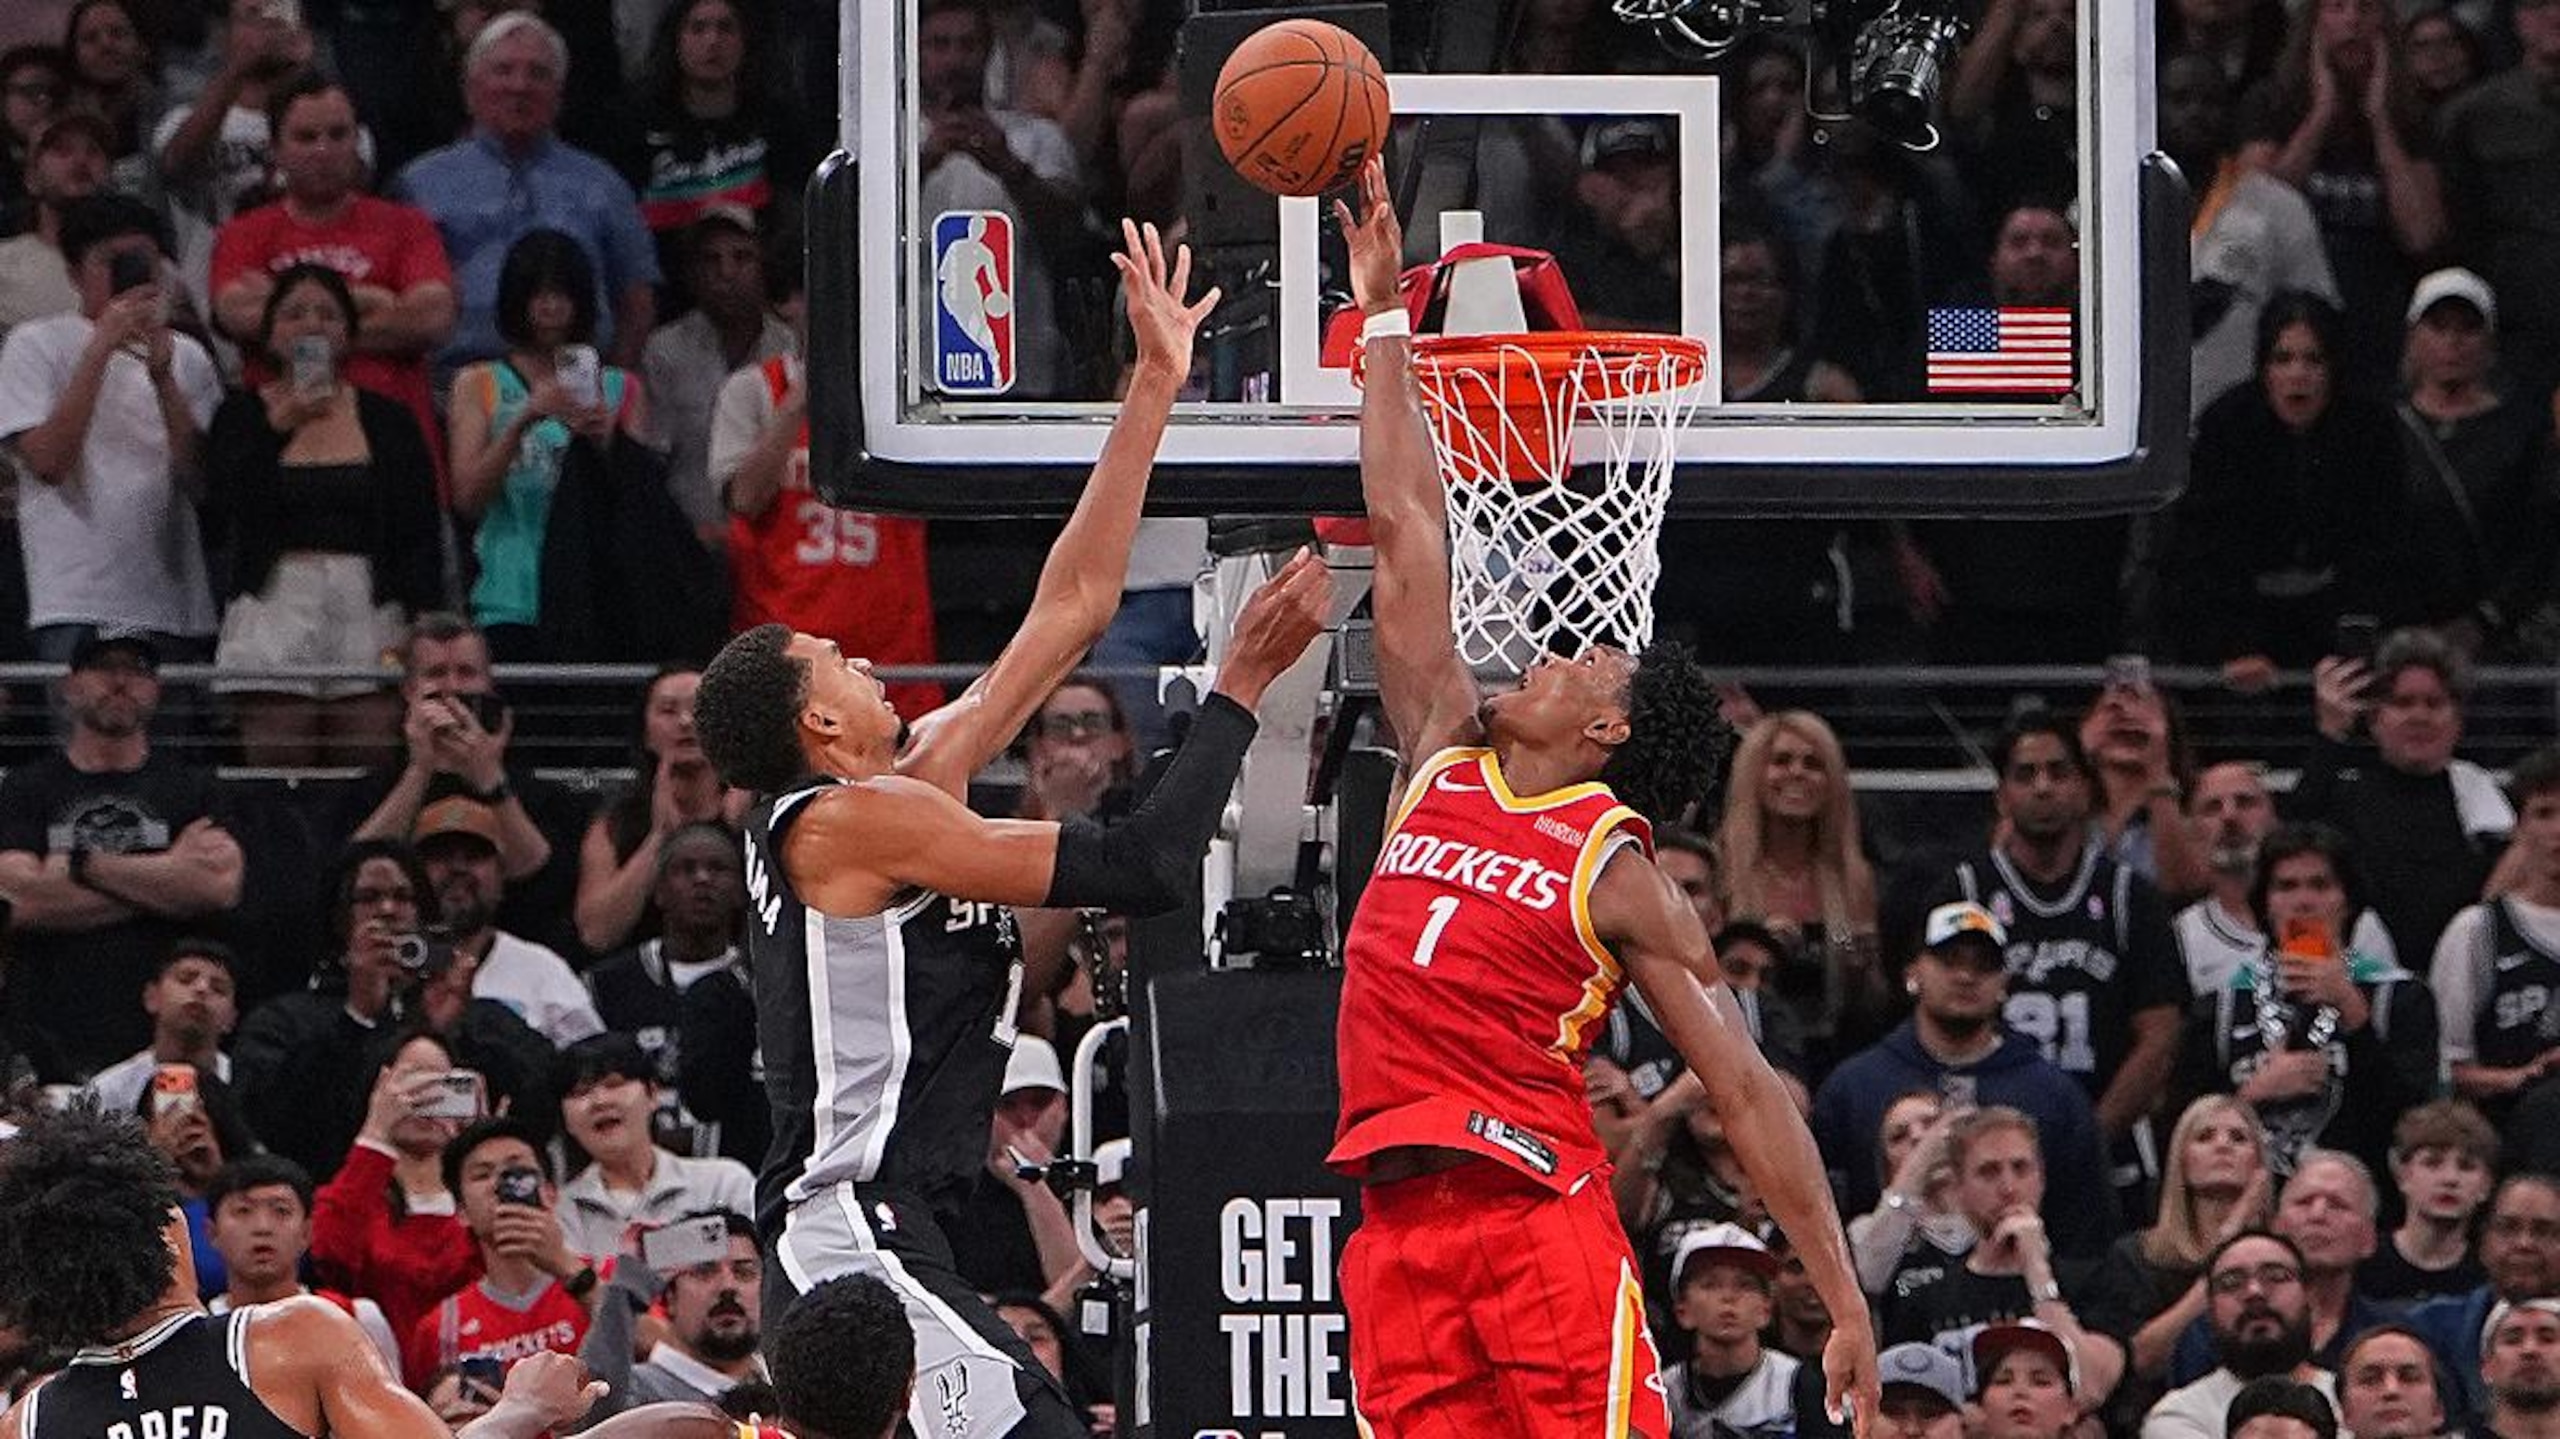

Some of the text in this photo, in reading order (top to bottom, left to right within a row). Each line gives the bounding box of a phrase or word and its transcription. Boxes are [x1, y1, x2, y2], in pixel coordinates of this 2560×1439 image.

[946, 352, 985, 382] NBA
[796, 501, 878, 566] 35
[1378, 833, 1570, 910] ROCKETS
[1412, 895, 1461, 968] 1
[2002, 990, 2096, 1073] 91
[1220, 1197, 1342, 1304] GET
[1219, 1314, 1347, 1417] THE
